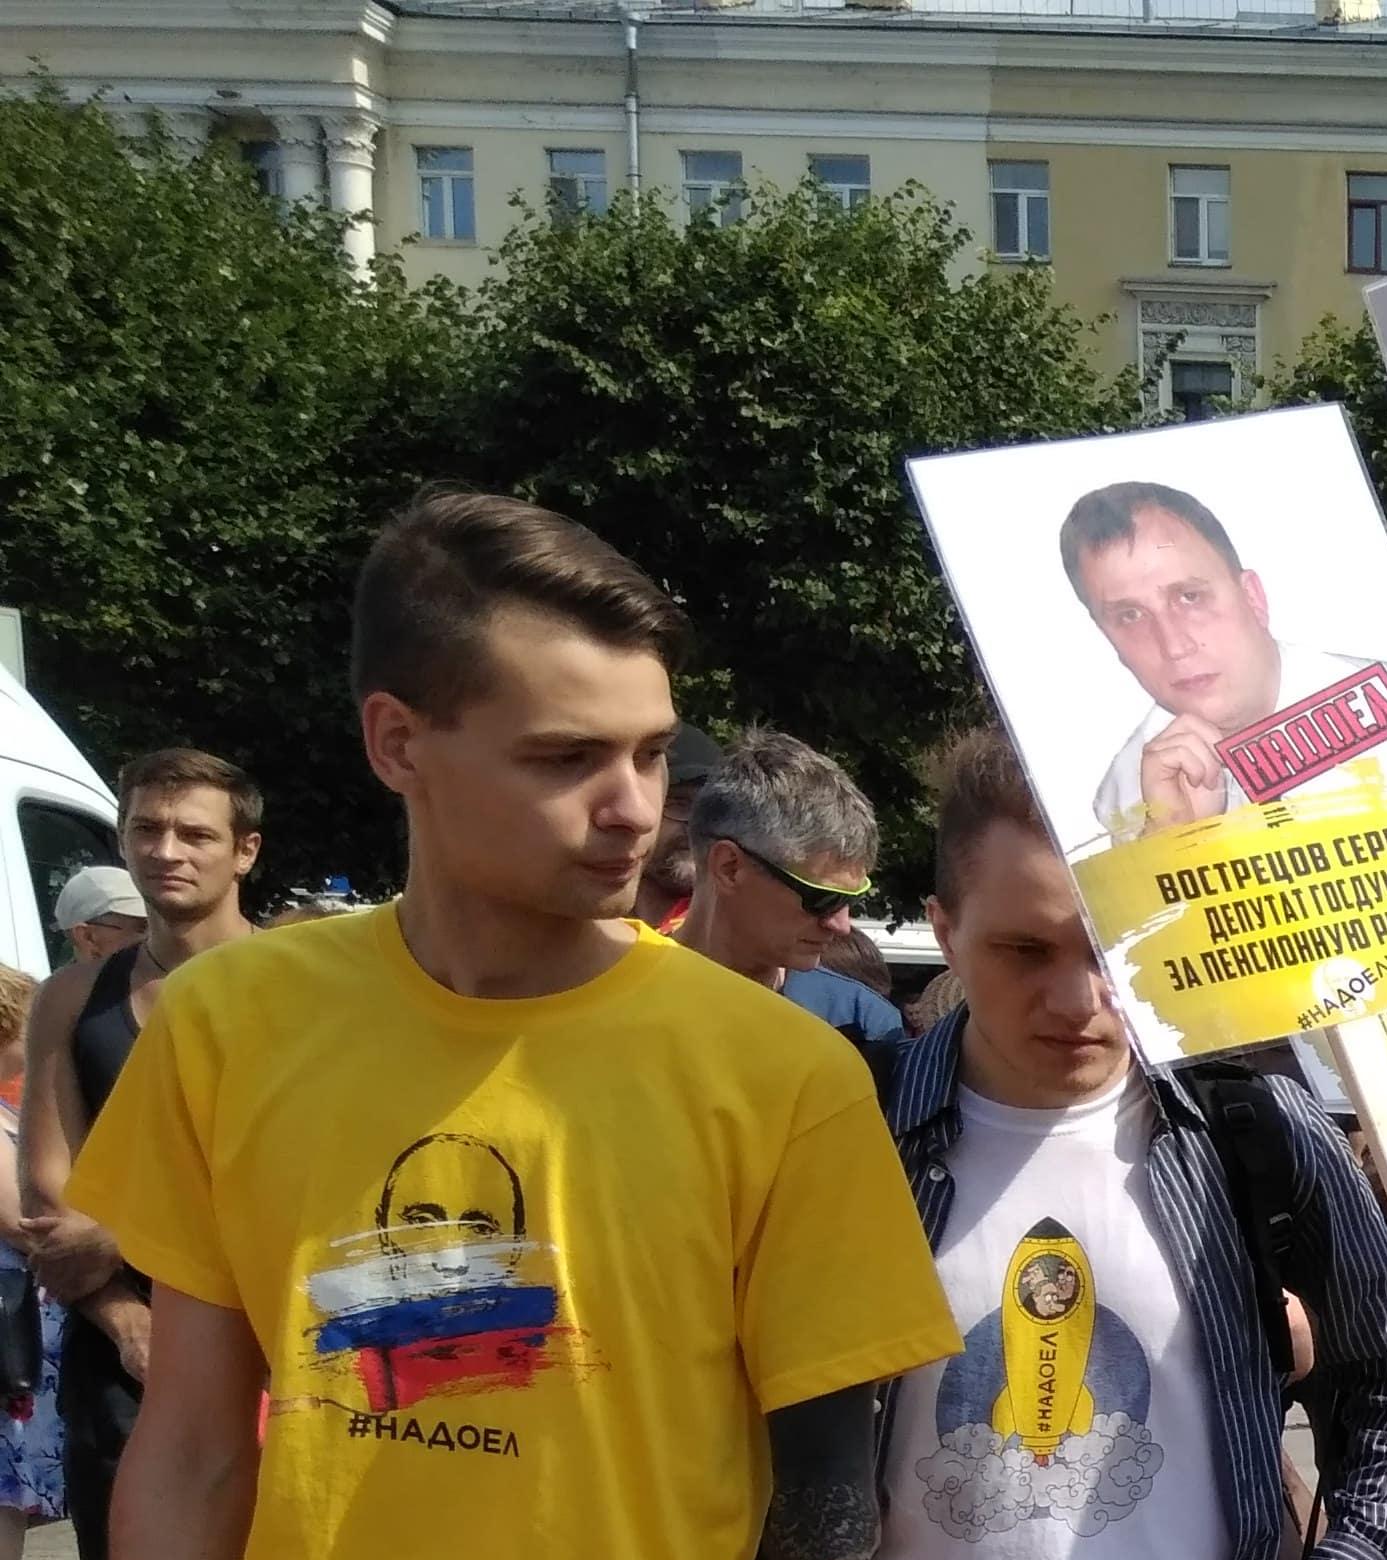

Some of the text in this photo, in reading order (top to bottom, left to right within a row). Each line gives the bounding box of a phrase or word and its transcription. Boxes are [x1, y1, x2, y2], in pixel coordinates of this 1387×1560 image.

[1156, 844, 1329, 905] ВОСТРЕЦОВ
[1204, 885, 1309, 945] ДЕПУТАТ
[1163, 957, 1203, 991] ЗА
[1201, 919, 1370, 986] ПЕНСИОННУЮ
[1038, 1331, 1059, 1433] #НАДОЕЛ
[348, 1413, 519, 1457] #НАДОЕЛ
